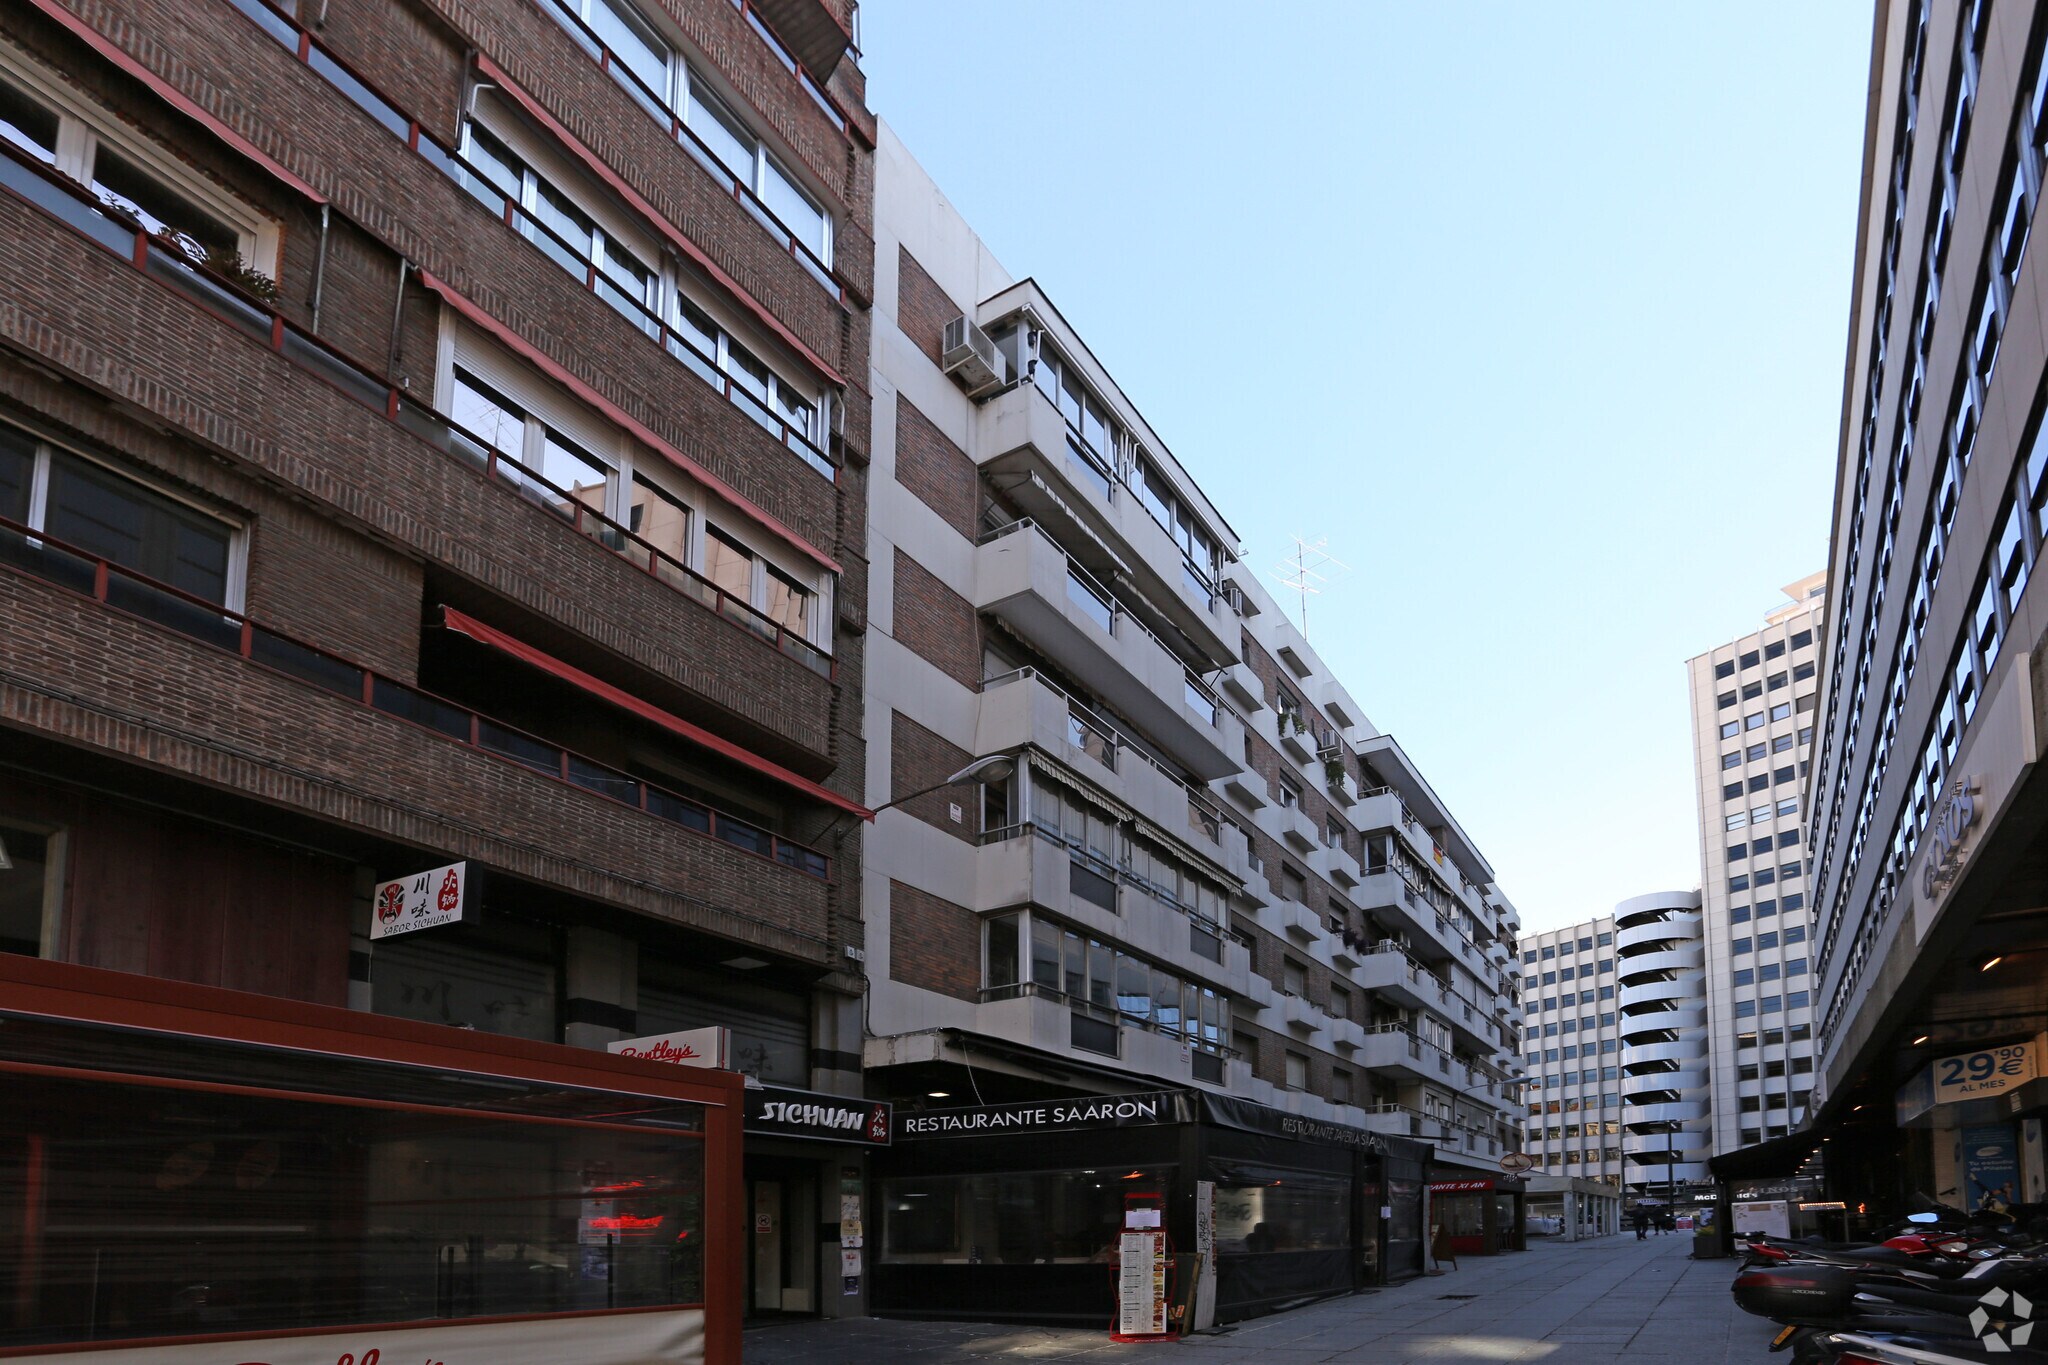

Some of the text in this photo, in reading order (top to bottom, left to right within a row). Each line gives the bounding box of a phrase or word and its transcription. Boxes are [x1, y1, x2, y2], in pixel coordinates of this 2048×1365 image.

[383, 913, 452, 936] SABOR SICHUAN
[1960, 1079, 2006, 1093] AL MES
[758, 1101, 865, 1131] SICHUAN
[906, 1099, 1157, 1133] RESTAURANTE SAARON
[1470, 1181, 1486, 1189] AN
